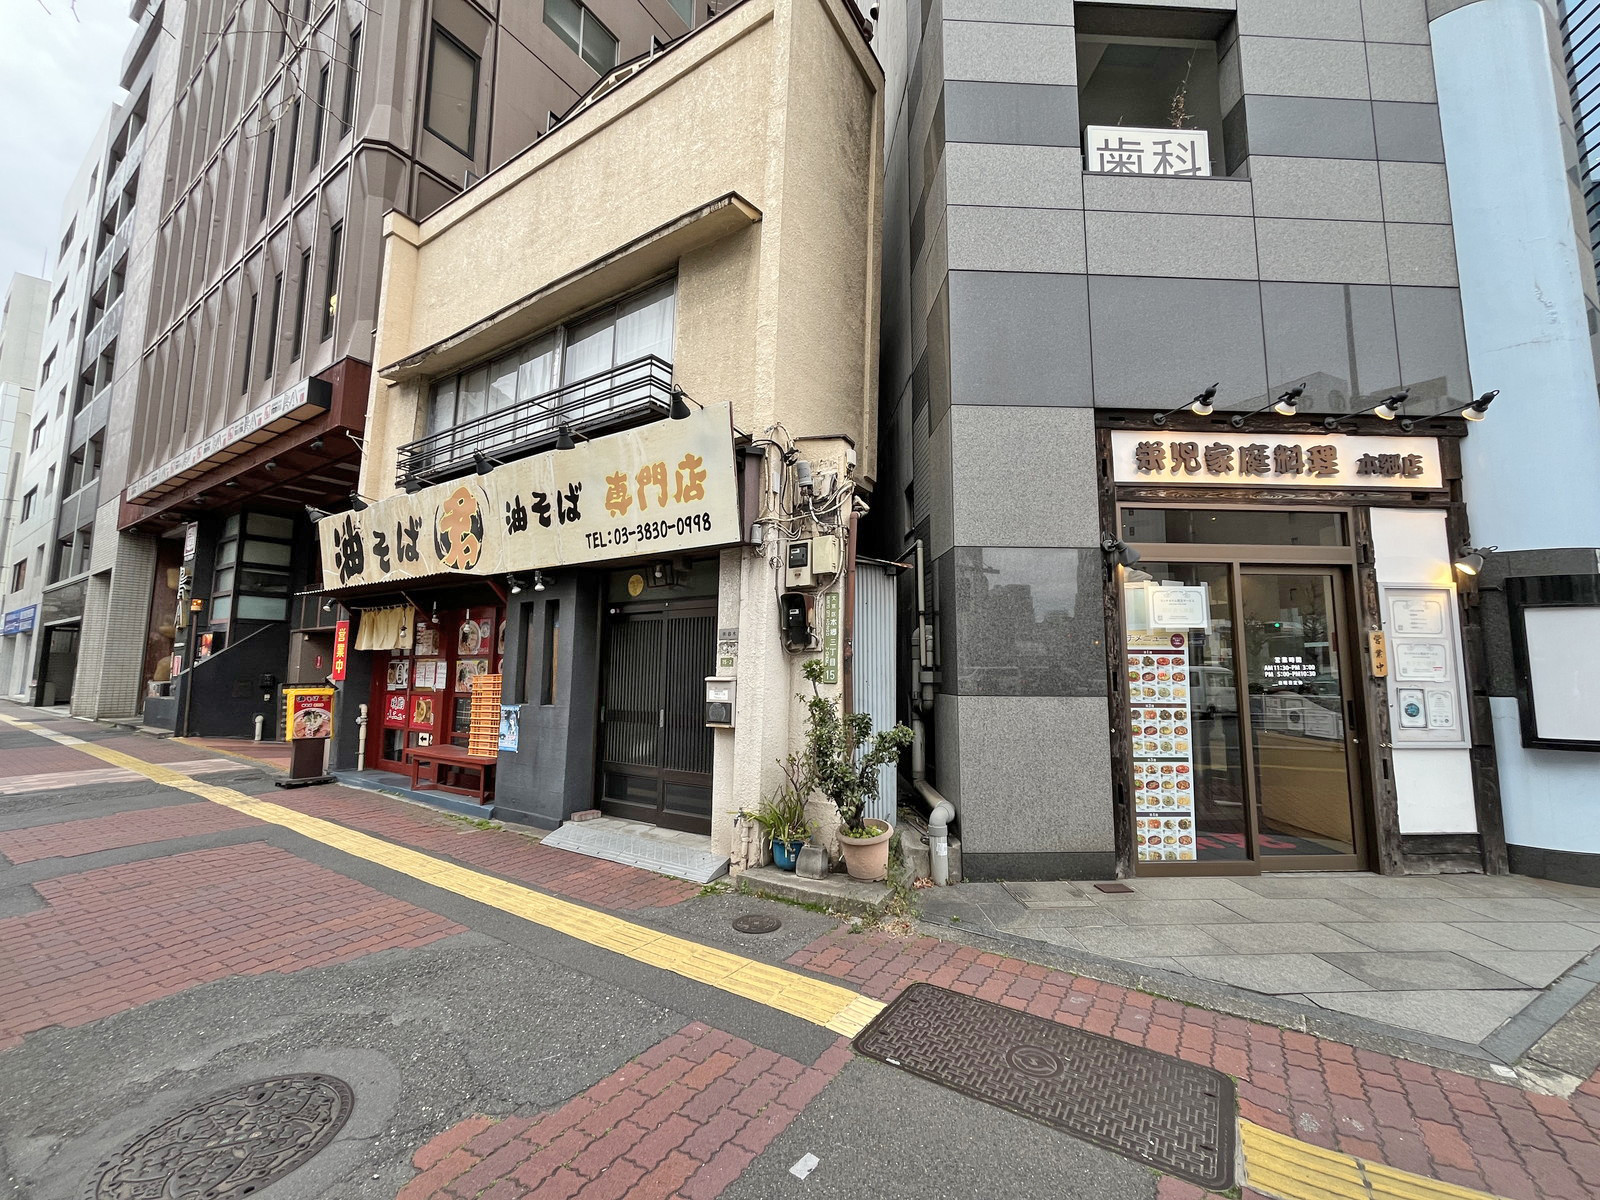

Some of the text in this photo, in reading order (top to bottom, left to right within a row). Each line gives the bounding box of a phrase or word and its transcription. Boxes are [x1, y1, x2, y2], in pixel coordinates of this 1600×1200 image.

[1096, 137, 1202, 177] 歯科
[1355, 452, 1425, 478] 本郷店
[334, 514, 423, 586] 油そば
[506, 480, 583, 536] 油そば
[585, 512, 712, 550] TEL:03-3830-0998
[334, 627, 348, 674] 営業中
[1373, 634, 1385, 672] 営業中
[825, 669, 836, 680] 15
